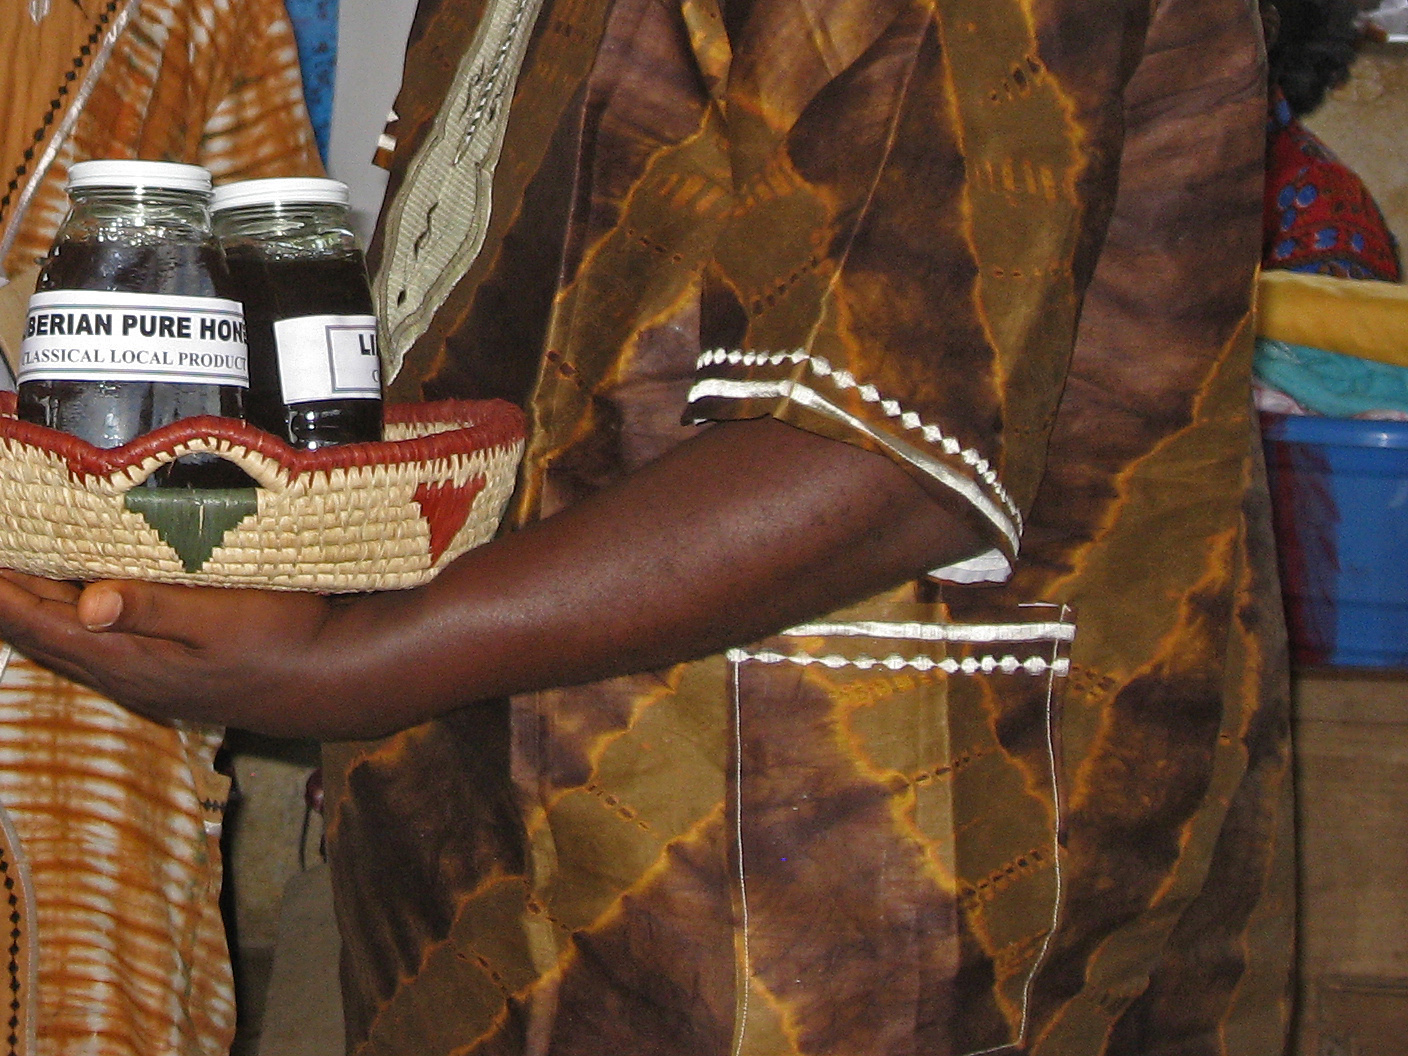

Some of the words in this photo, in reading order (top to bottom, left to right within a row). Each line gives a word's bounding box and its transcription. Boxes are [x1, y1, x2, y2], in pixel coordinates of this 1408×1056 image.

[24, 313, 112, 338] BERIAN
[122, 314, 192, 339] PURE
[110, 349, 173, 365] LOCAL
